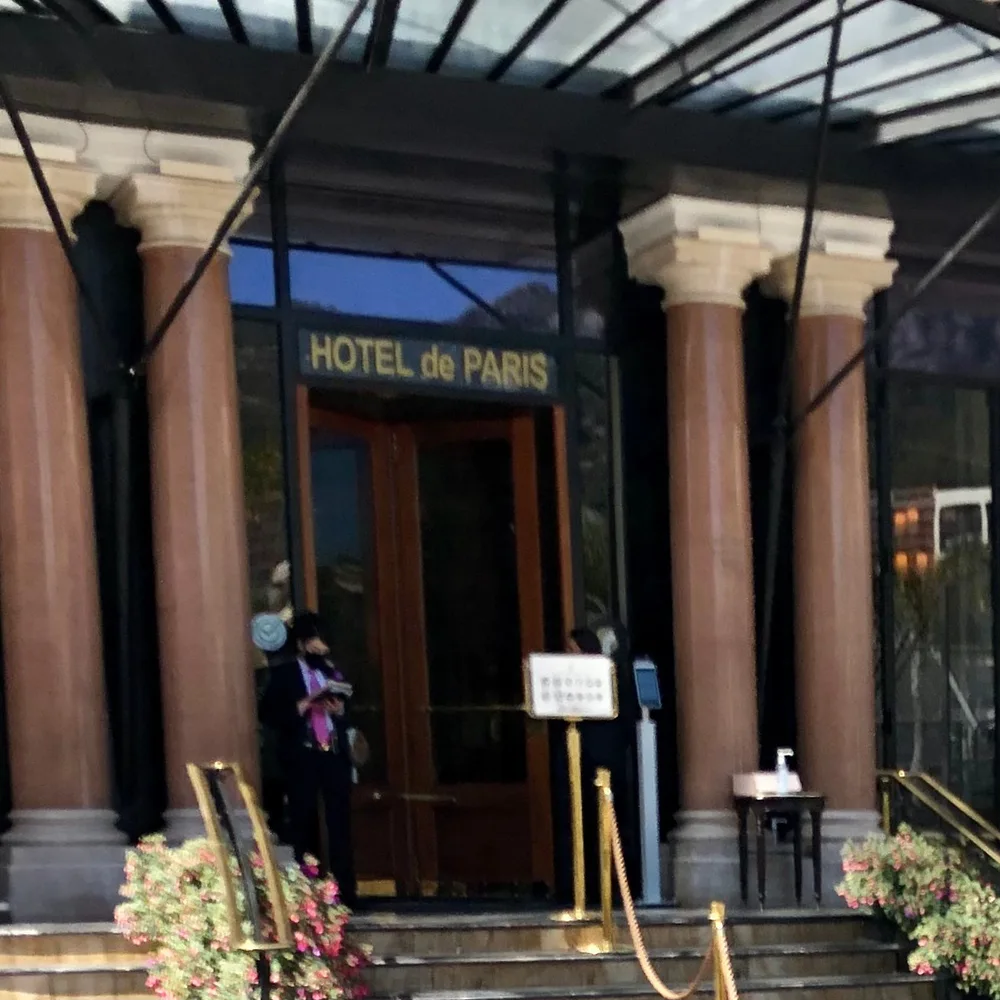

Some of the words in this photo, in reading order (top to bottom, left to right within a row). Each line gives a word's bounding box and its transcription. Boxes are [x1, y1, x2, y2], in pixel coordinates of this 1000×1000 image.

[310, 332, 414, 378] HOTEL
[420, 343, 455, 382] de
[463, 345, 549, 393] PARIS
